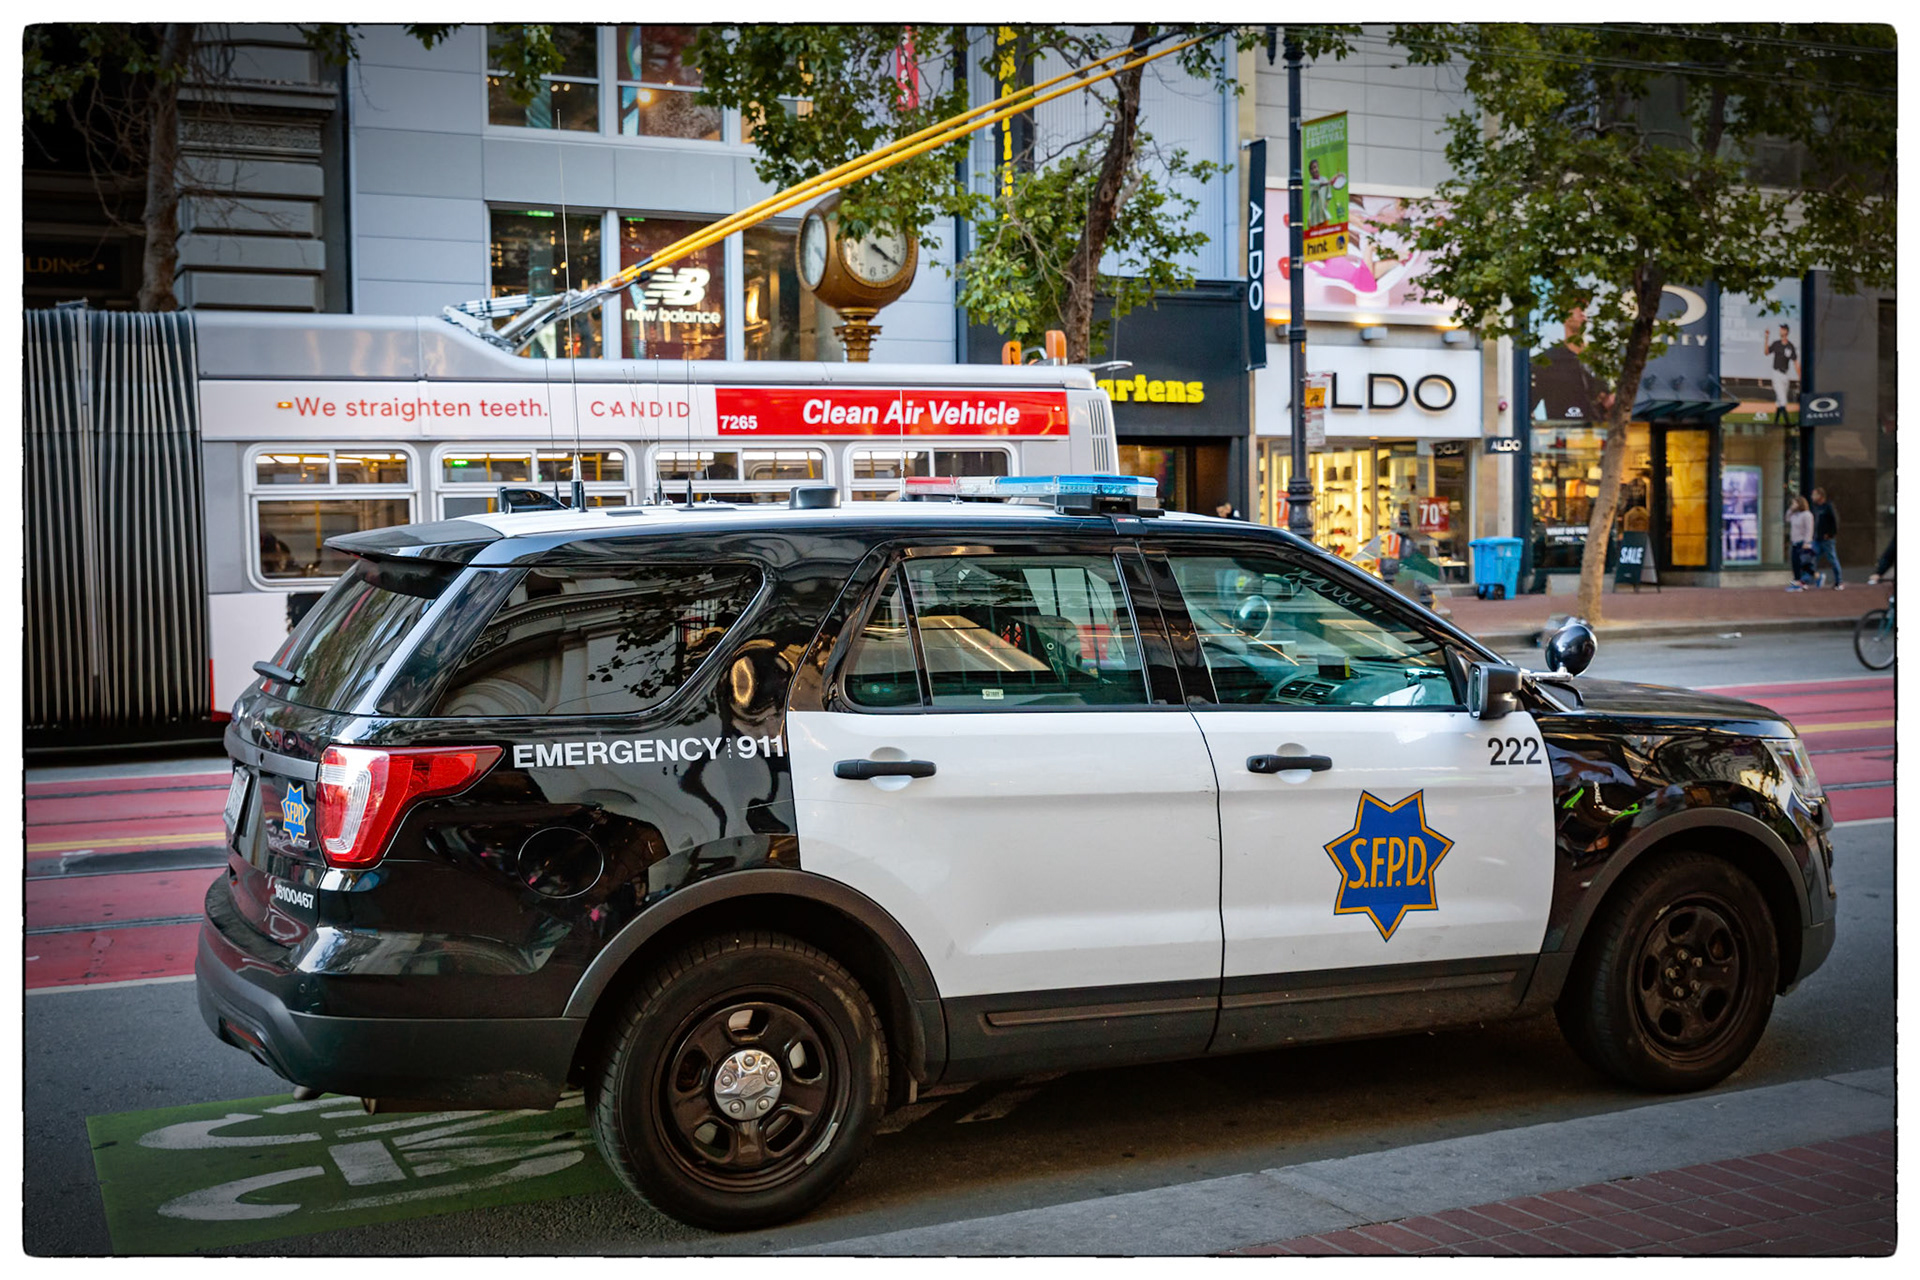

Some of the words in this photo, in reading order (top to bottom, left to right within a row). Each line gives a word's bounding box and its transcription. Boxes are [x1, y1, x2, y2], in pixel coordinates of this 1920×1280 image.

[1249, 201, 1263, 310] ALDO
[1307, 239, 1328, 255] hint
[625, 308, 657, 322] new
[659, 307, 721, 324] balance
[1092, 372, 1205, 403] artens
[1286, 372, 1457, 412] LDO
[295, 397, 336, 417] We
[346, 398, 471, 422] straighten
[480, 398, 549, 417] teeth.
[590, 401, 691, 418] CANDID
[719, 415, 758, 430] 7265
[803, 399, 879, 425] Clean
[883, 400, 924, 425] Air
[928, 401, 1020, 426] Vehicle
[1491, 439, 1522, 452] ALDO
[1620, 546, 1644, 564] SALE
[513, 737, 722, 768] EMERGENCY
[736, 735, 784, 759] 911
[1487, 736, 1542, 766] 222
[1347, 836, 1427, 889] S.F.P.D.
[274, 883, 314, 910] 16100467
